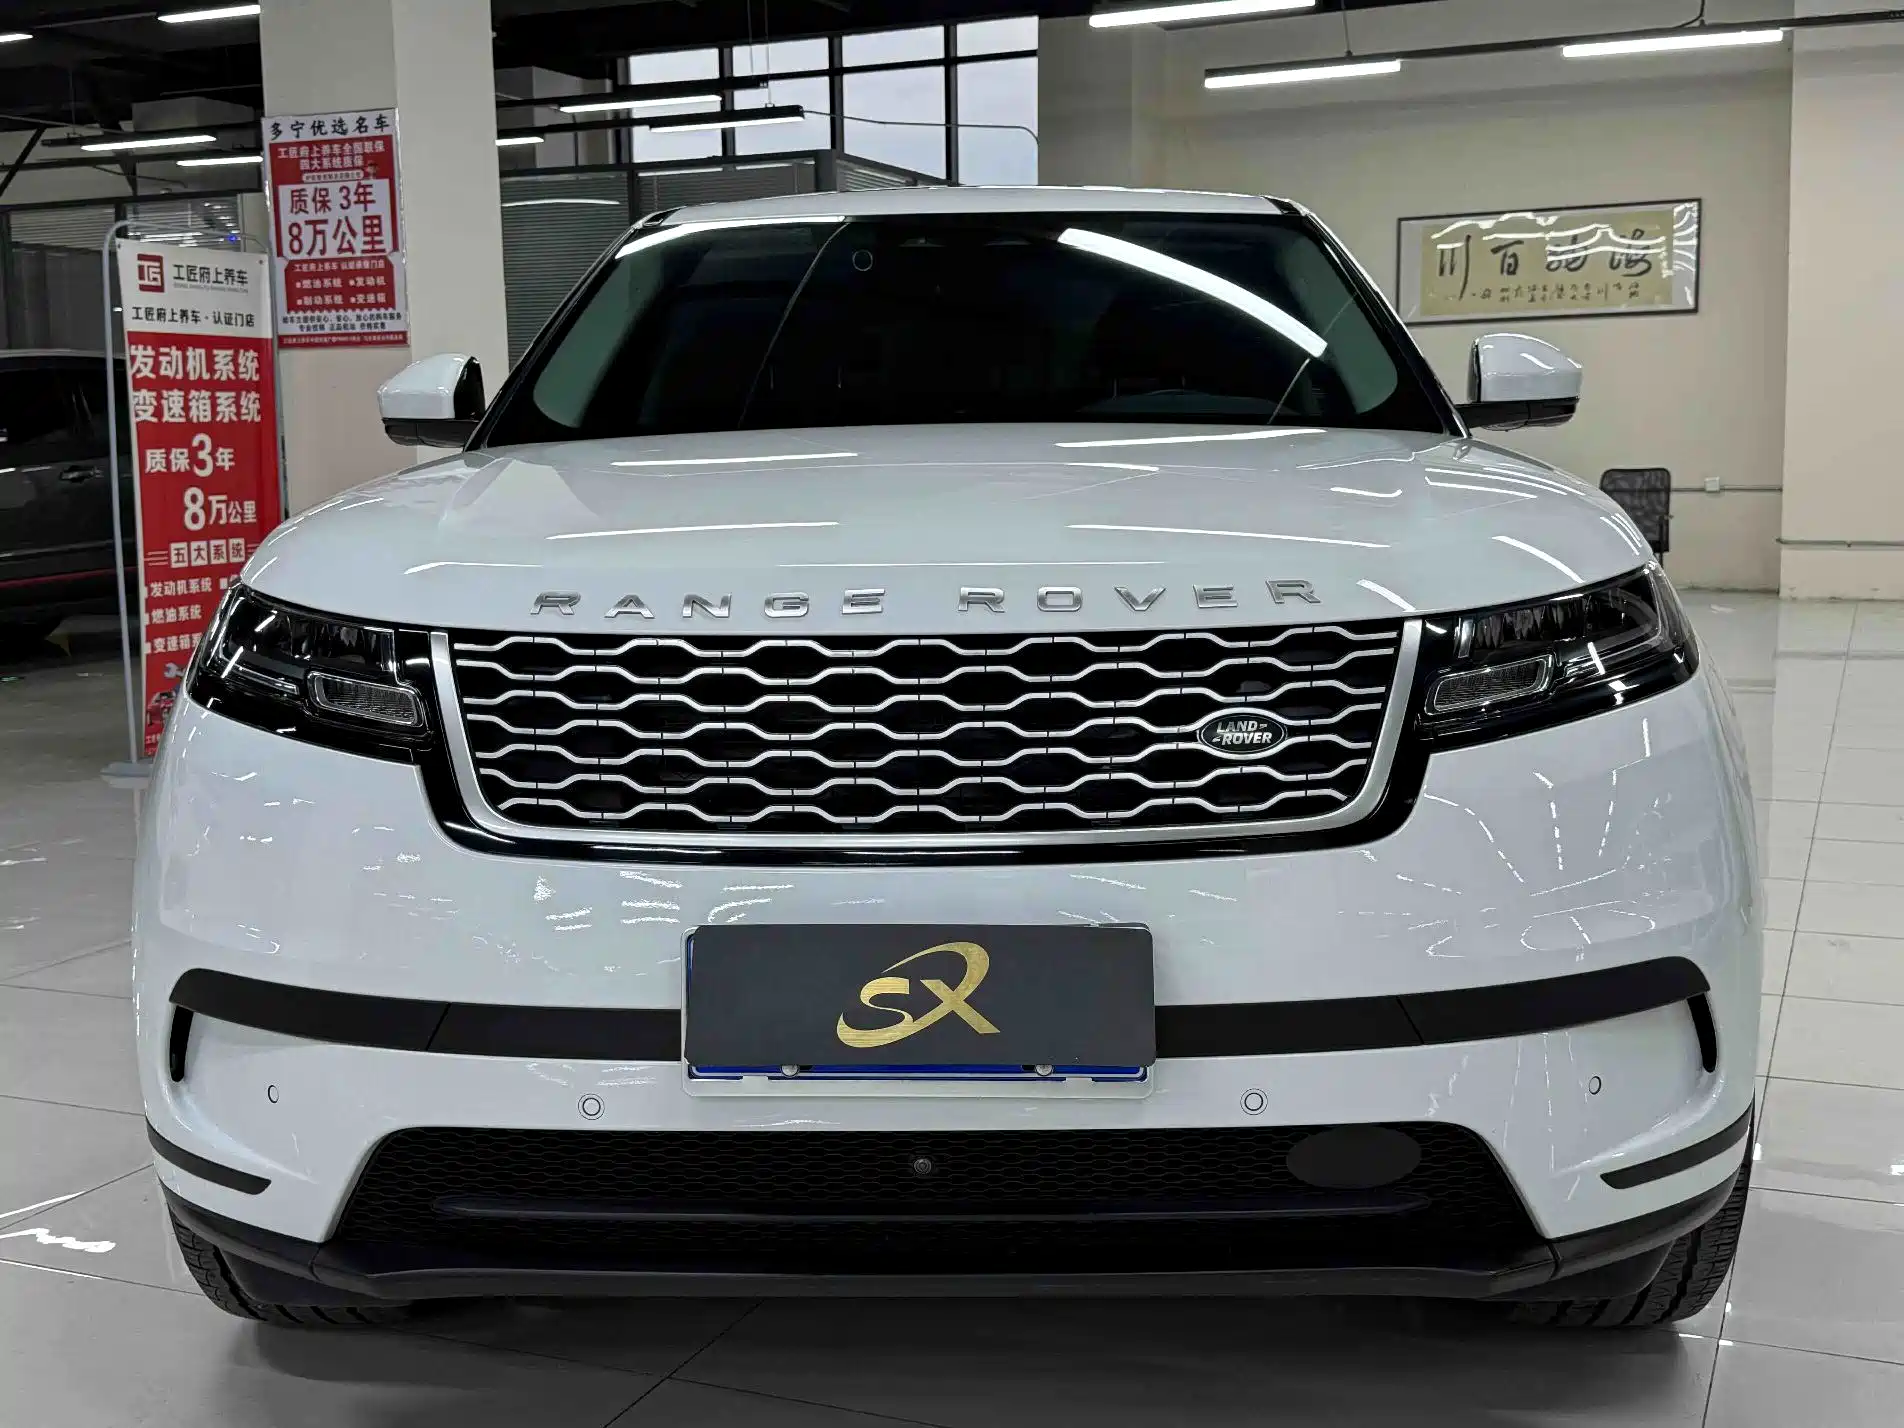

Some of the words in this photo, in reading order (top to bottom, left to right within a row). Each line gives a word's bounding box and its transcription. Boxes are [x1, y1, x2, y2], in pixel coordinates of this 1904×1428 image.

[269, 114, 390, 140] 多宁优选名车
[288, 216, 386, 255] 8万公里
[172, 263, 249, 286] 工匠府上养车
[130, 344, 260, 382] 发动机系统
[132, 389, 262, 424] 变速箱系统
[144, 432, 235, 477] 质保3年
[183, 486, 257, 531] 8万公里
[173, 541, 244, 563] 五大系统
[150, 577, 212, 598] 发动机系统
[531, 588, 886, 619] RANGE
[958, 579, 1322, 613] ROVER
[1216, 720, 1258, 733] LAND
[1221, 732, 1273, 746] ROVER
